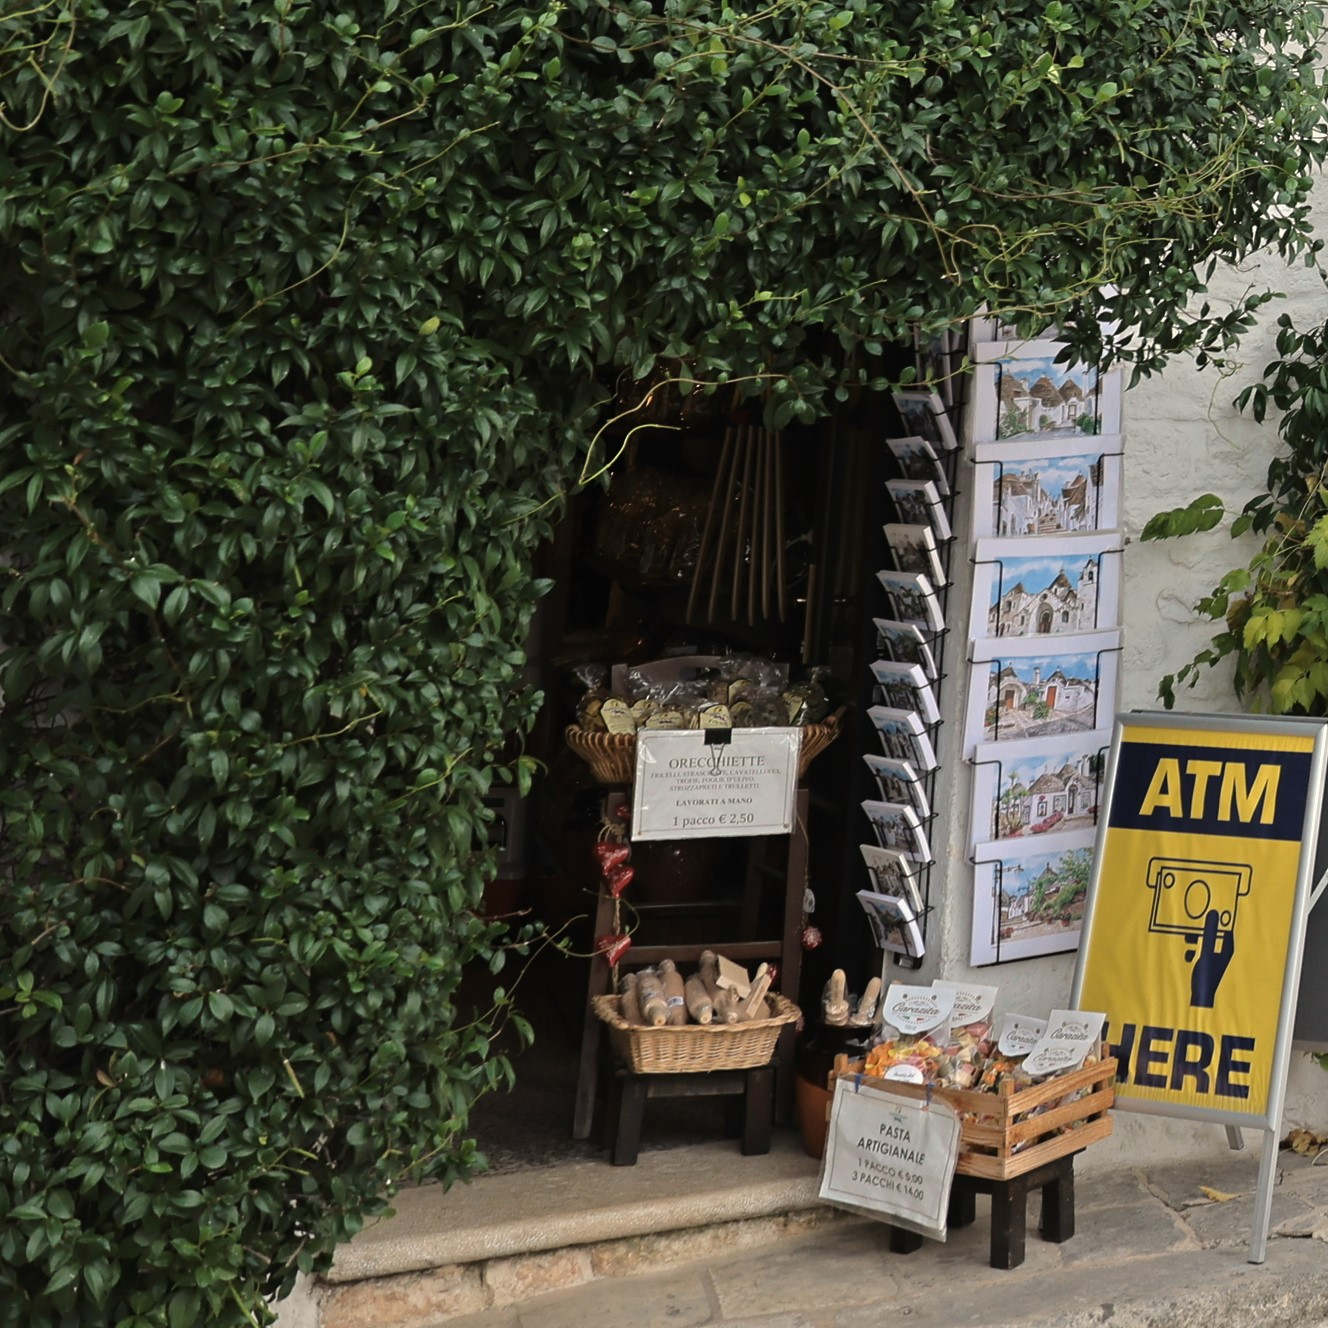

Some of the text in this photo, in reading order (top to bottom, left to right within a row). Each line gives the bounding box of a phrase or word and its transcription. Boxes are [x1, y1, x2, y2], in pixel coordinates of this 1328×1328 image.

[1138, 756, 1282, 826] ATM
[676, 798, 718, 808] LAVORATI
[727, 796, 753, 806] MANO
[672, 812, 755, 829] 1 pacco € 2,50
[1100, 1020, 1256, 1100] HERE
[879, 1122, 911, 1143] PASTA
[857, 1136, 927, 1166] ARTIGIANALE
[864, 1159, 897, 1178] PACCO
[851, 1170, 858, 1182] 3
[859, 1172, 896, 1191] PACCHI
